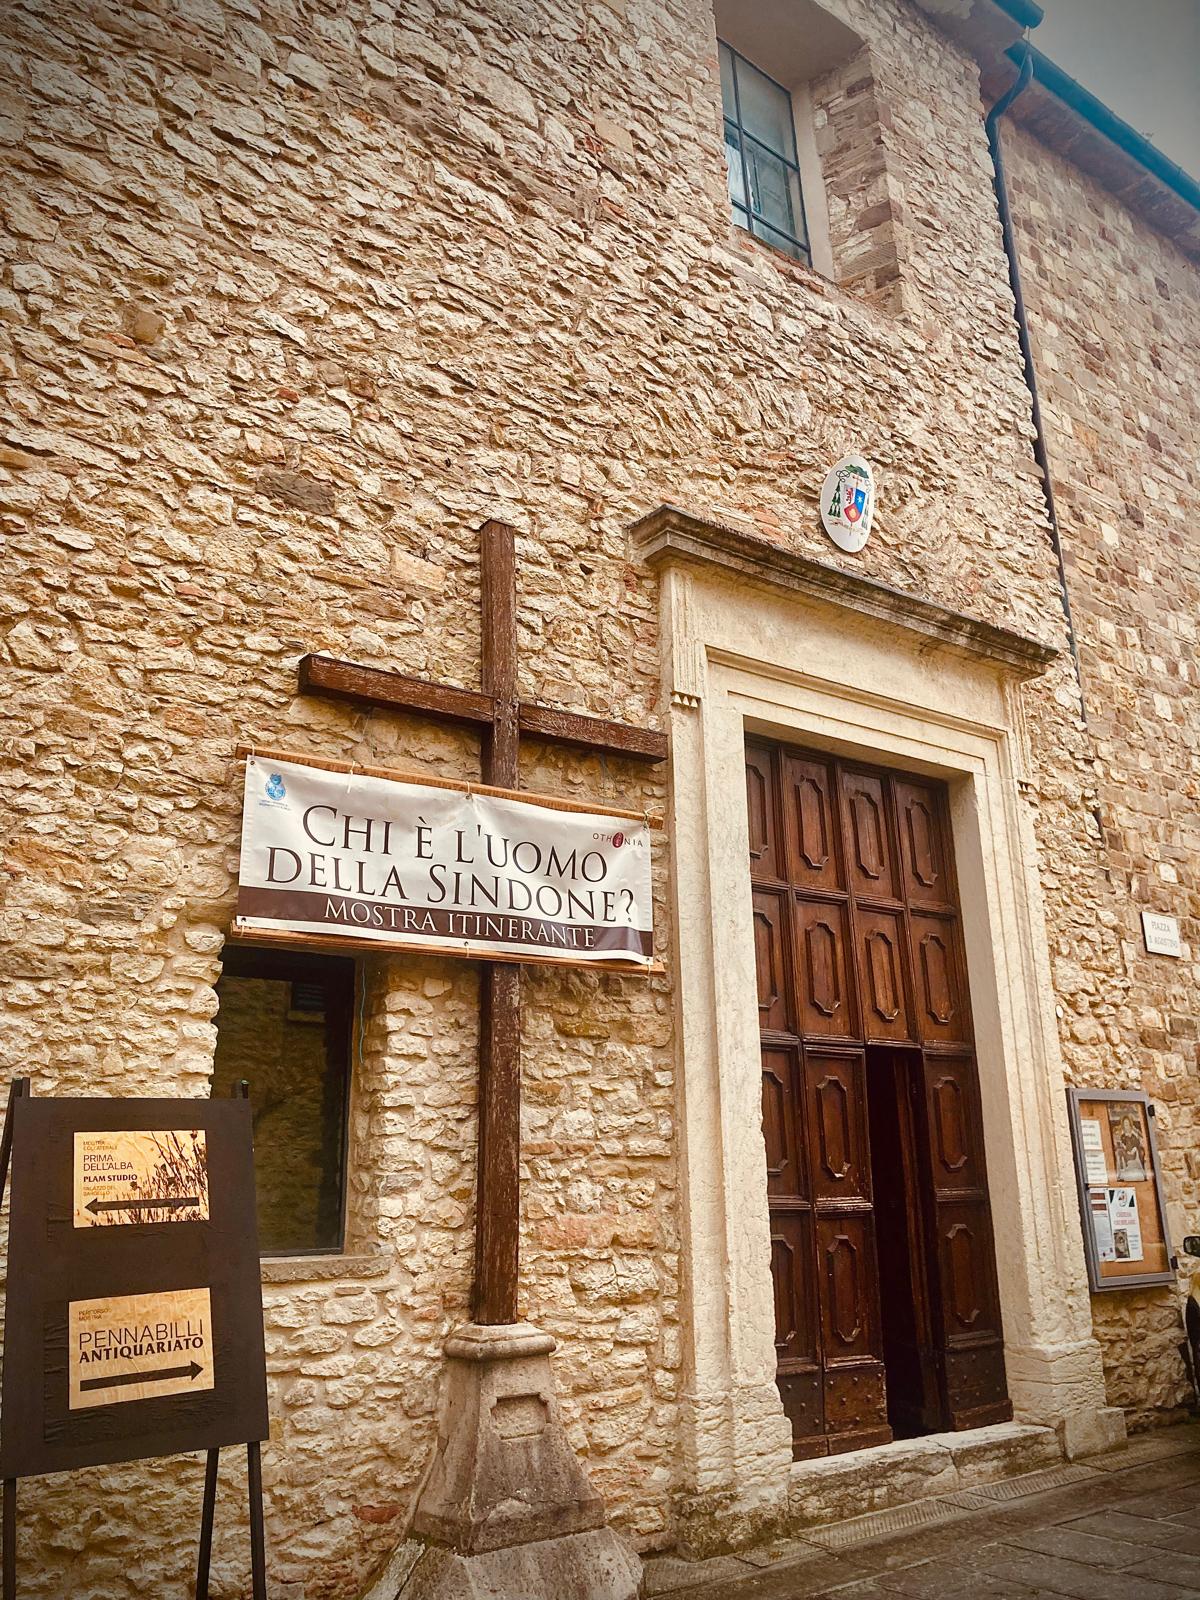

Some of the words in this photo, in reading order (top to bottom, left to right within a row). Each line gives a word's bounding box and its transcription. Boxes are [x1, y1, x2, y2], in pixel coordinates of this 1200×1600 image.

[303, 805, 393, 855] CHI
[415, 816, 434, 859] È
[454, 824, 608, 883] L'UOMO
[265, 847, 409, 900] DELLA
[427, 864, 634, 923] SINDONE?
[324, 897, 438, 932] MOSTRA
[447, 913, 595, 947] ITINERANTE
[83, 1154, 114, 1162] PRIMA
[83, 1161, 134, 1171] DELL'ALBA
[107, 1174, 138, 1182] STUDIO
[79, 1318, 203, 1350] PENNABILLI
[79, 1336, 204, 1364] ANTIQUARIATO
